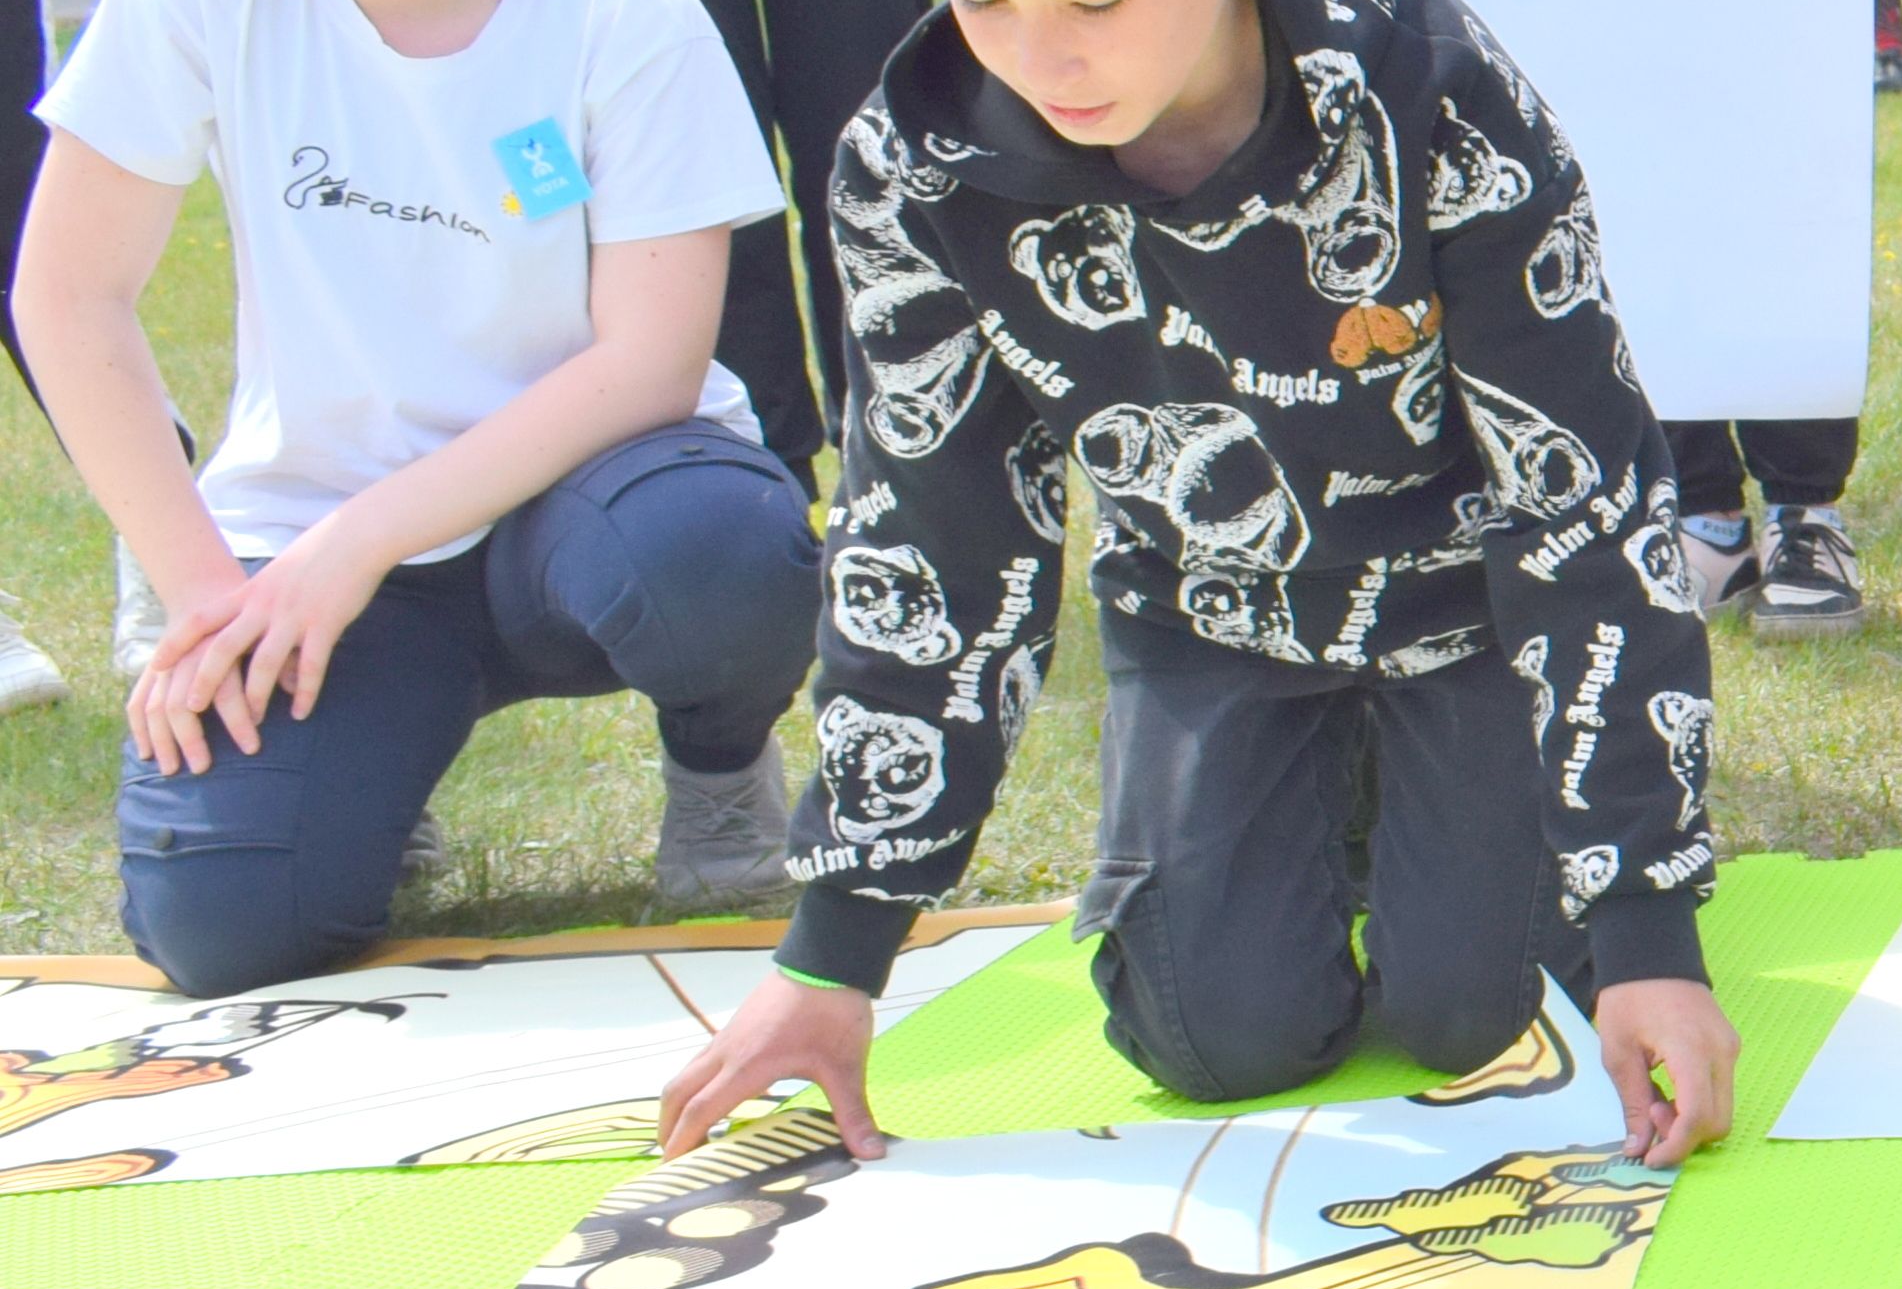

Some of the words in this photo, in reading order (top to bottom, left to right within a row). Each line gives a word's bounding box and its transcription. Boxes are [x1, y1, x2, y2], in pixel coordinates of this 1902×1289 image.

[1230, 356, 1342, 409] Angels
[974, 557, 1040, 649] Angels
[1565, 621, 1625, 727] Angels
